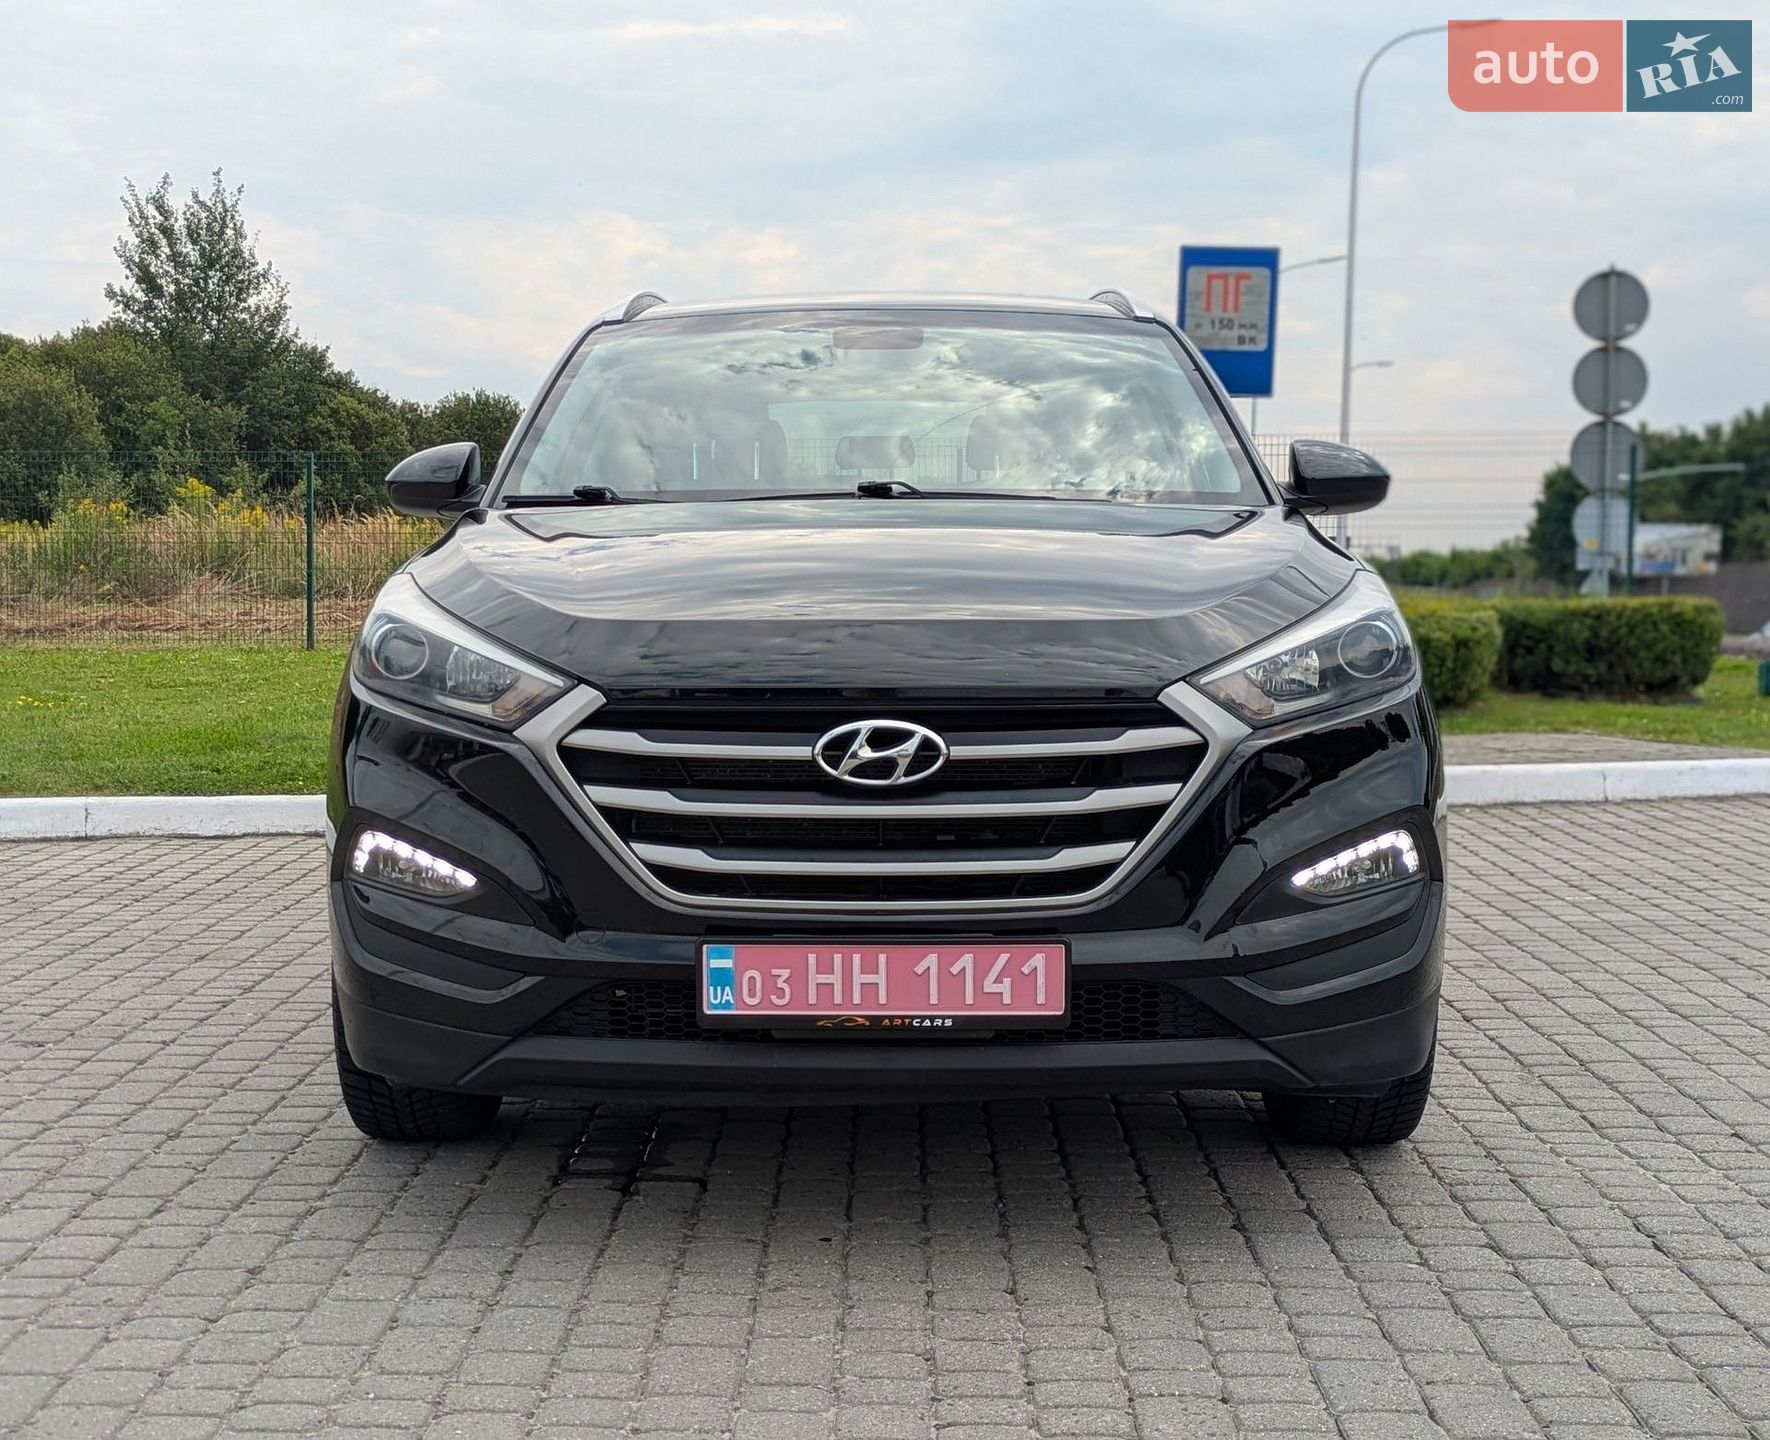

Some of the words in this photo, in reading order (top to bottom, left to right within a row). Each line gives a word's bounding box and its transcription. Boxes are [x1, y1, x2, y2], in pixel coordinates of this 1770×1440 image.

[1210, 318, 1235, 331] 150
[741, 969, 792, 1006] 03
[807, 953, 887, 1006] HH
[913, 953, 1046, 1006] 1141
[709, 986, 734, 1004] UA
